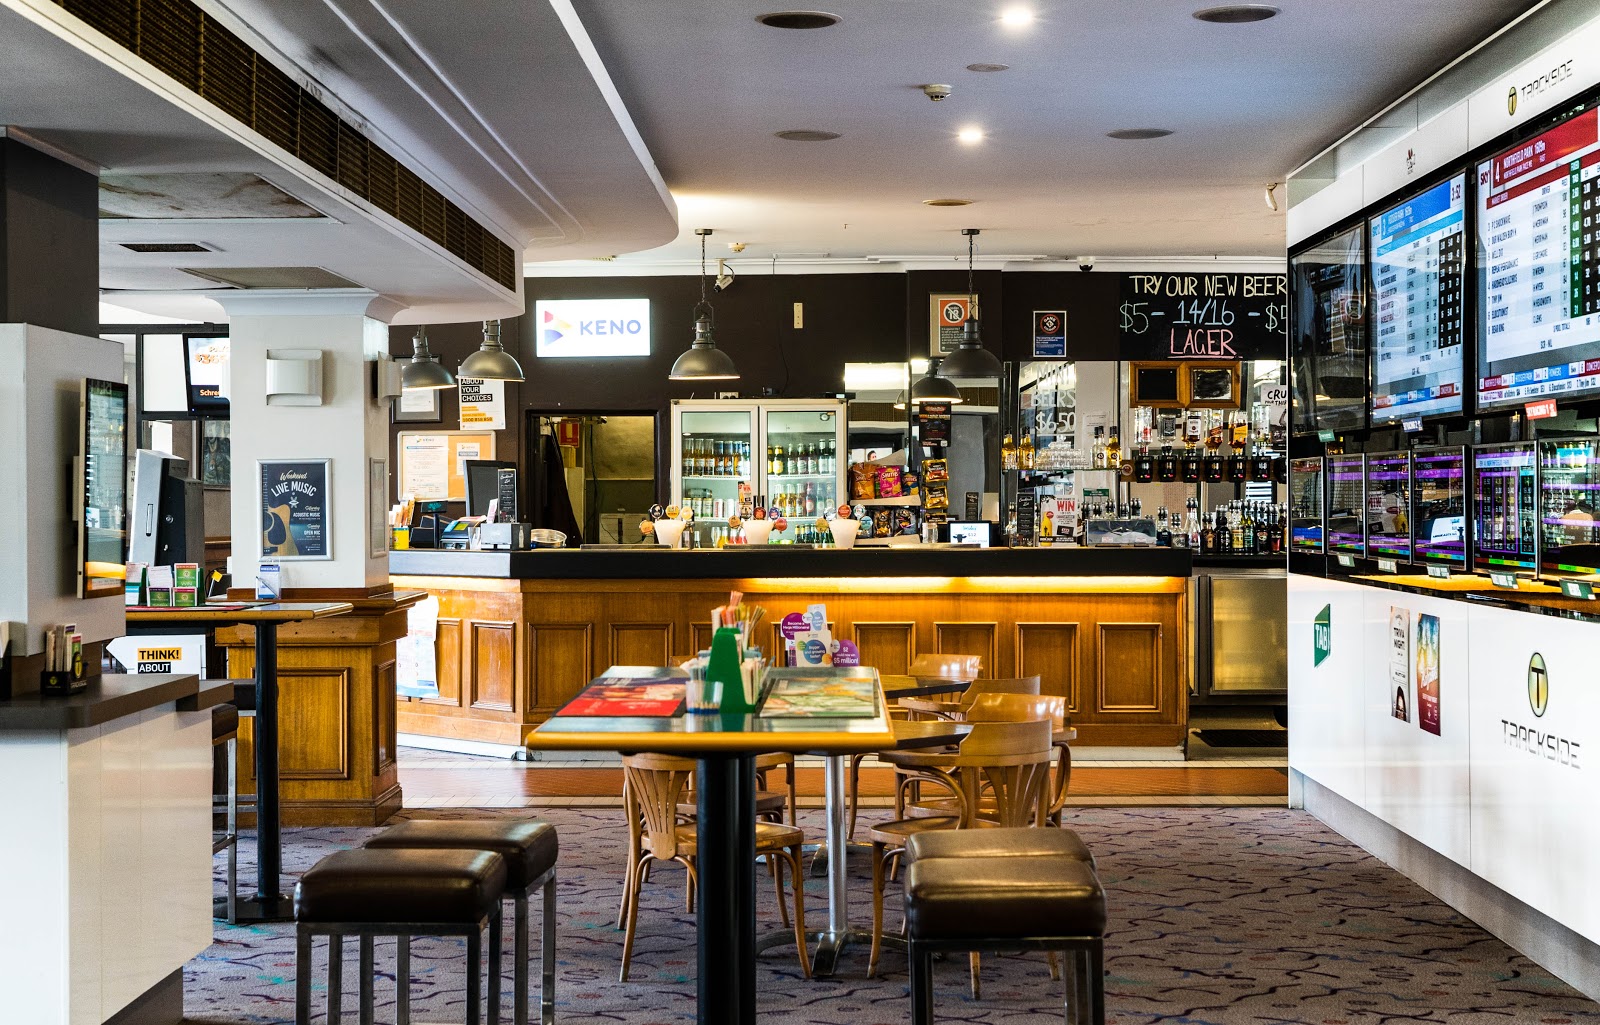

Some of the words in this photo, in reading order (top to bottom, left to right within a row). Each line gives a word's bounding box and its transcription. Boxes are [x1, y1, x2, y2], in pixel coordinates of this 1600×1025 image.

[1521, 60, 1573, 102] TRACKSIDE
[1129, 275, 1162, 295] TRY
[1166, 275, 1198, 296] OUR
[1205, 275, 1237, 296] NEW
[1173, 298, 1235, 325] 14/16
[579, 319, 642, 336] KENO
[1170, 327, 1238, 355] LAGER
[1036, 364, 1070, 385] MINI
[462, 394, 492, 402] CHOICES
[1031, 389, 1076, 408] BEERS
[271, 481, 290, 497] LIVE
[291, 481, 317, 497] MUSIC
[1056, 500, 1075, 512] WIN
[1315, 624, 1328, 651] TAB
[139, 650, 179, 660] THINK!
[139, 663, 170, 673] ABOUT
[1501, 719, 1580, 770] TRACKSIDE
